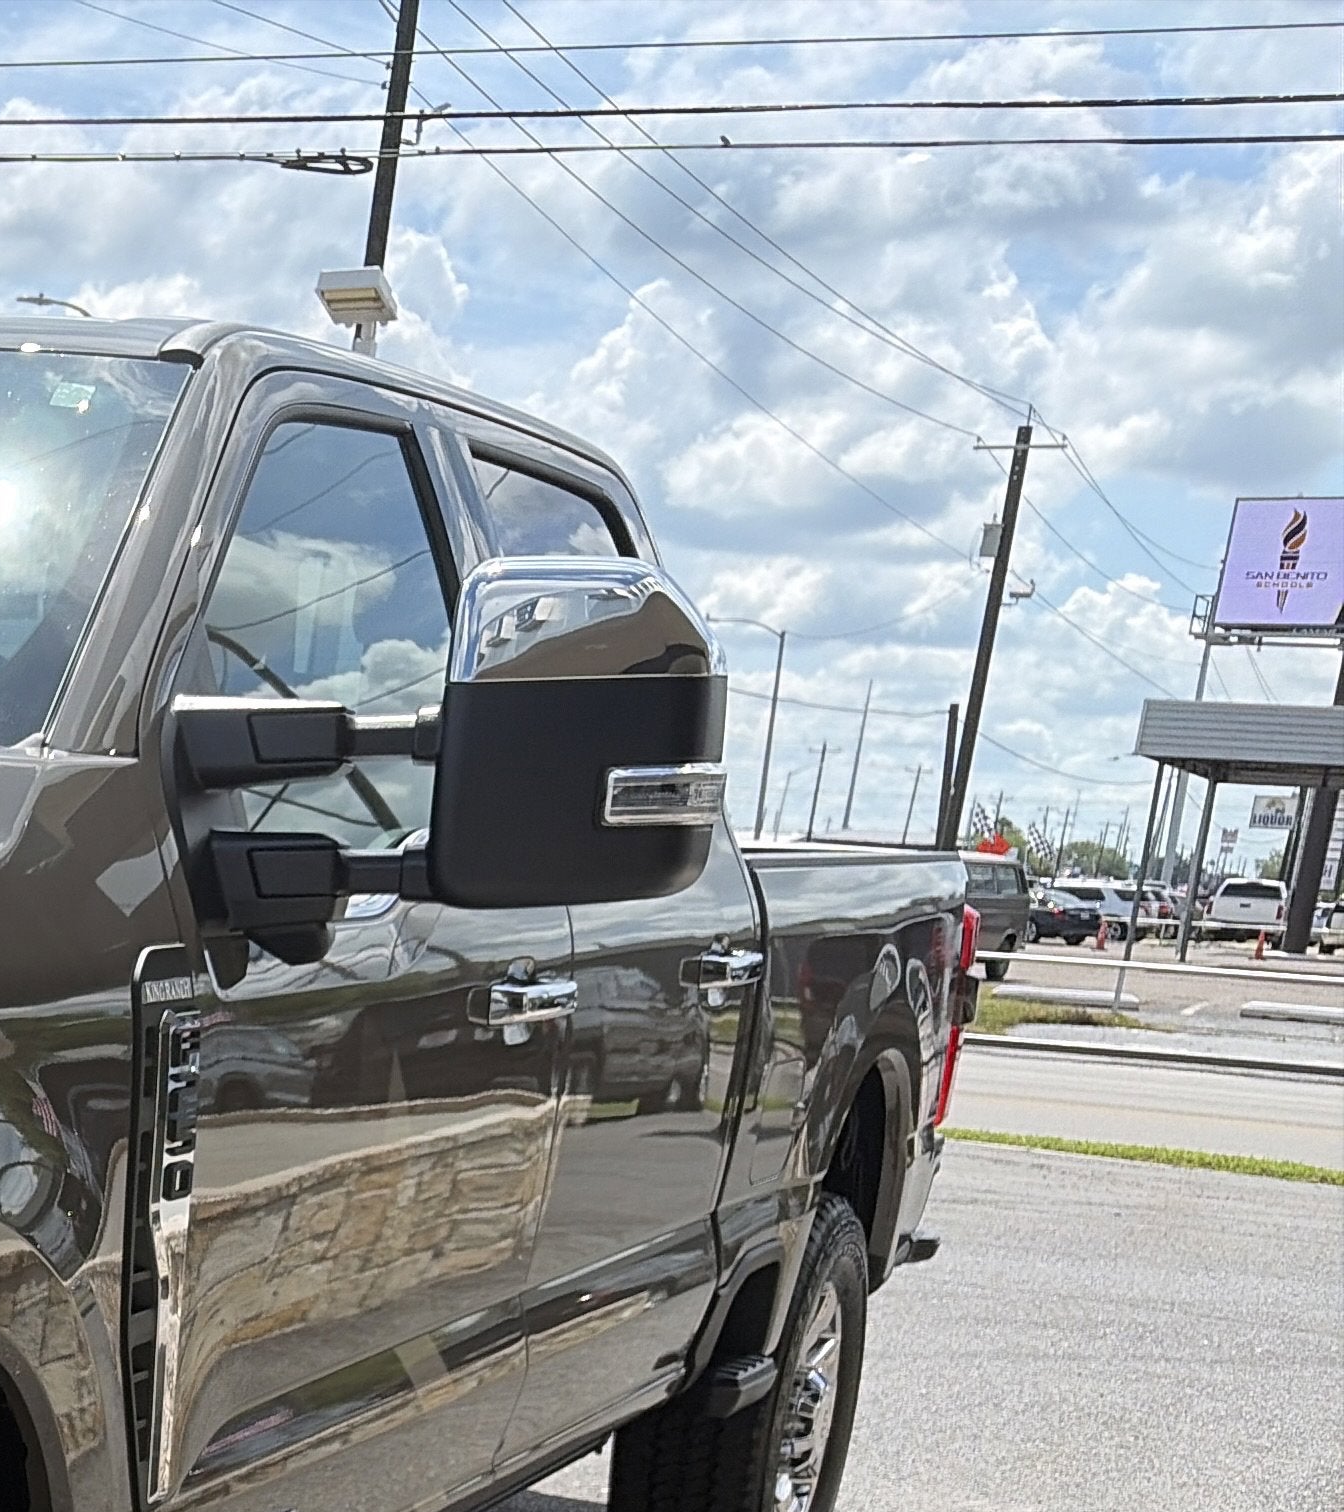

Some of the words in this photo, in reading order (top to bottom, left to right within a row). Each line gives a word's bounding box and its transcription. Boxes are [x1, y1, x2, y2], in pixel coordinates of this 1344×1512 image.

[1245, 571, 1274, 580] SAN
[1277, 571, 1328, 581] BENITO
[1252, 812, 1293, 826] LIQUOR
